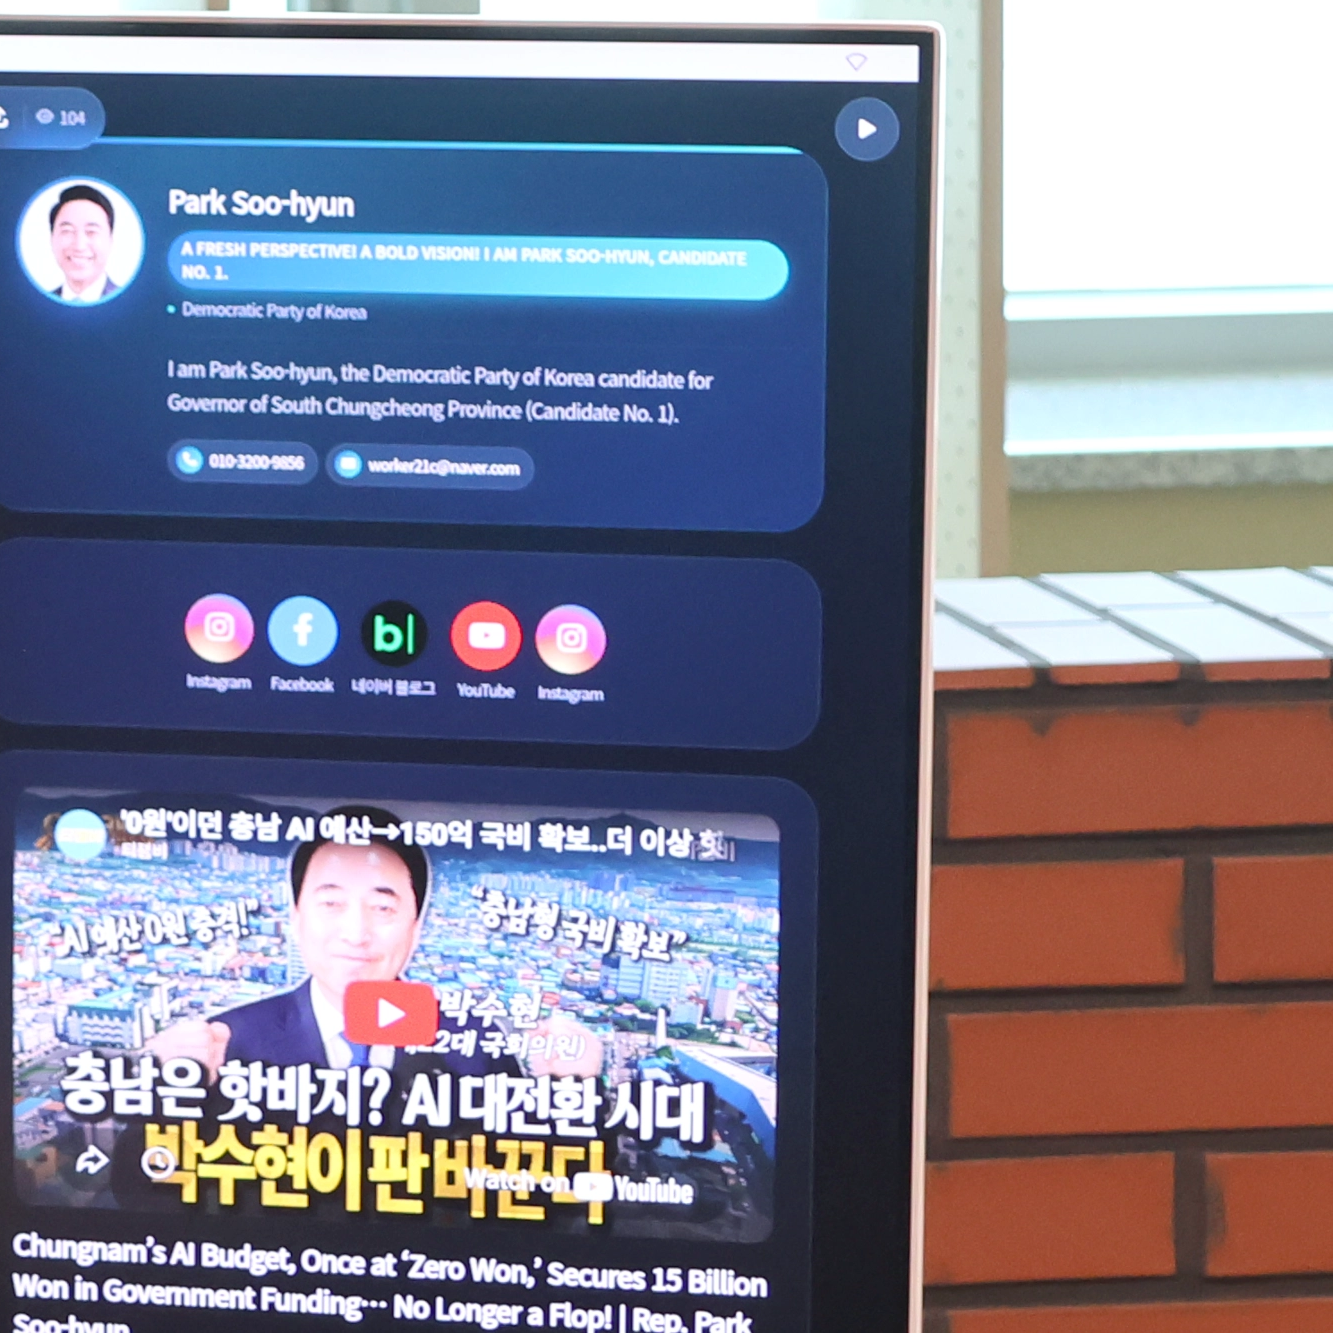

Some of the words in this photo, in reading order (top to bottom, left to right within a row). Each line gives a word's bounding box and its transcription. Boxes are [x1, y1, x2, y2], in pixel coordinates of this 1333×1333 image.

[60, 110, 86, 126] 104
[168, 188, 227, 216] Park
[231, 188, 355, 223] Soo-hyun
[181, 241, 193, 256] A
[196, 241, 246, 257] FRESH
[250, 243, 357, 259] PERSPECTIVE!
[360, 244, 372, 259] A
[375, 245, 418, 260] BOLD
[421, 246, 480, 261] VISION!
[484, 247, 490, 261] I
[493, 247, 518, 262] AM
[521, 248, 563, 263] PARK
[565, 249, 655, 267] SOO-HYUN,
[658, 250, 747, 266] CANDIDATE
[181, 265, 210, 280] NO.
[214, 265, 229, 280] 1.
[182, 302, 264, 319] Democratic
[266, 303, 303, 322] Party
[307, 303, 322, 319] of
[325, 305, 367, 321] Korea
[168, 359, 174, 378] I
[177, 363, 205, 379] am
[210, 360, 248, 380] Park
[251, 361, 338, 386] Soo-hyun,
[341, 363, 369, 382] the
[373, 364, 471, 384] Democratic
[474, 366, 520, 390] Party
[522, 366, 542, 386] of
[545, 368, 595, 388] Korea
[598, 369, 685, 389] candidate
[688, 370, 714, 390] for
[167, 393, 247, 413] Governor
[249, 394, 270, 413] of
[270, 395, 322, 415] South
[325, 397, 445, 423] Chungcheong
[448, 399, 523, 420] Province
[525, 399, 620, 422] (Candidate
[624, 403, 654, 424] No.
[658, 402, 679, 426] 1).
[209, 453, 306, 471] 010-3200-9856
[368, 457, 520, 477] worker21c@naver.com
[186, 673, 252, 693] Instagram
[270, 676, 334, 693] Facebook
[351, 677, 393, 695] 네이버
[395, 679, 437, 696] 블로그
[456, 682, 516, 700] YouTube
[537, 685, 605, 705] Instagram
[120, 808, 222, 840] '0원'이던
[228, 811, 282, 842] 충남
[285, 816, 314, 841] AI
[479, 821, 531, 852] 국비
[639, 826, 693, 858] 이상
[91, 913, 142, 954] 예산
[144, 907, 189, 945] 0원
[562, 913, 616, 955] 국비
[439, 988, 542, 1029] 박수현
[60, 1050, 206, 1118] 충남은
[217, 1059, 392, 1126] 핫바지?
[402, 1072, 452, 1127] AI
[459, 1072, 603, 1138] 대전환
[605, 1079, 705, 1143] 시대
[145, 1119, 361, 1212] 박수현이
[367, 1131, 430, 1214] 판
[464, 1168, 535, 1192] Watch
[539, 1174, 572, 1193] on
[614, 1174, 694, 1204] YouTube
[13, 1231, 167, 1266] Chungnam’s
[170, 1242, 195, 1266] AI
[201, 1242, 297, 1276] Budget,
[301, 1248, 366, 1275] Once
[370, 1251, 397, 1277] at
[400, 1249, 466, 1281] ‘Zero
[469, 1256, 542, 1289] Won,’
[547, 1261, 646, 1292] Secures
[651, 1267, 682, 1293] 15
[688, 1268, 768, 1298] Billion
[12, 1272, 69, 1300] Won
[74, 1274, 99, 1301] in
[102, 1277, 256, 1311] Government
[393, 1293, 431, 1320] No
[435, 1296, 523, 1330] Longer
[526, 1308, 545, 1326] a
[549, 1302, 613, 1332] Flop!
[632, 1307, 689, 1333] Rep.
[694, 1311, 752, 1333] Park
